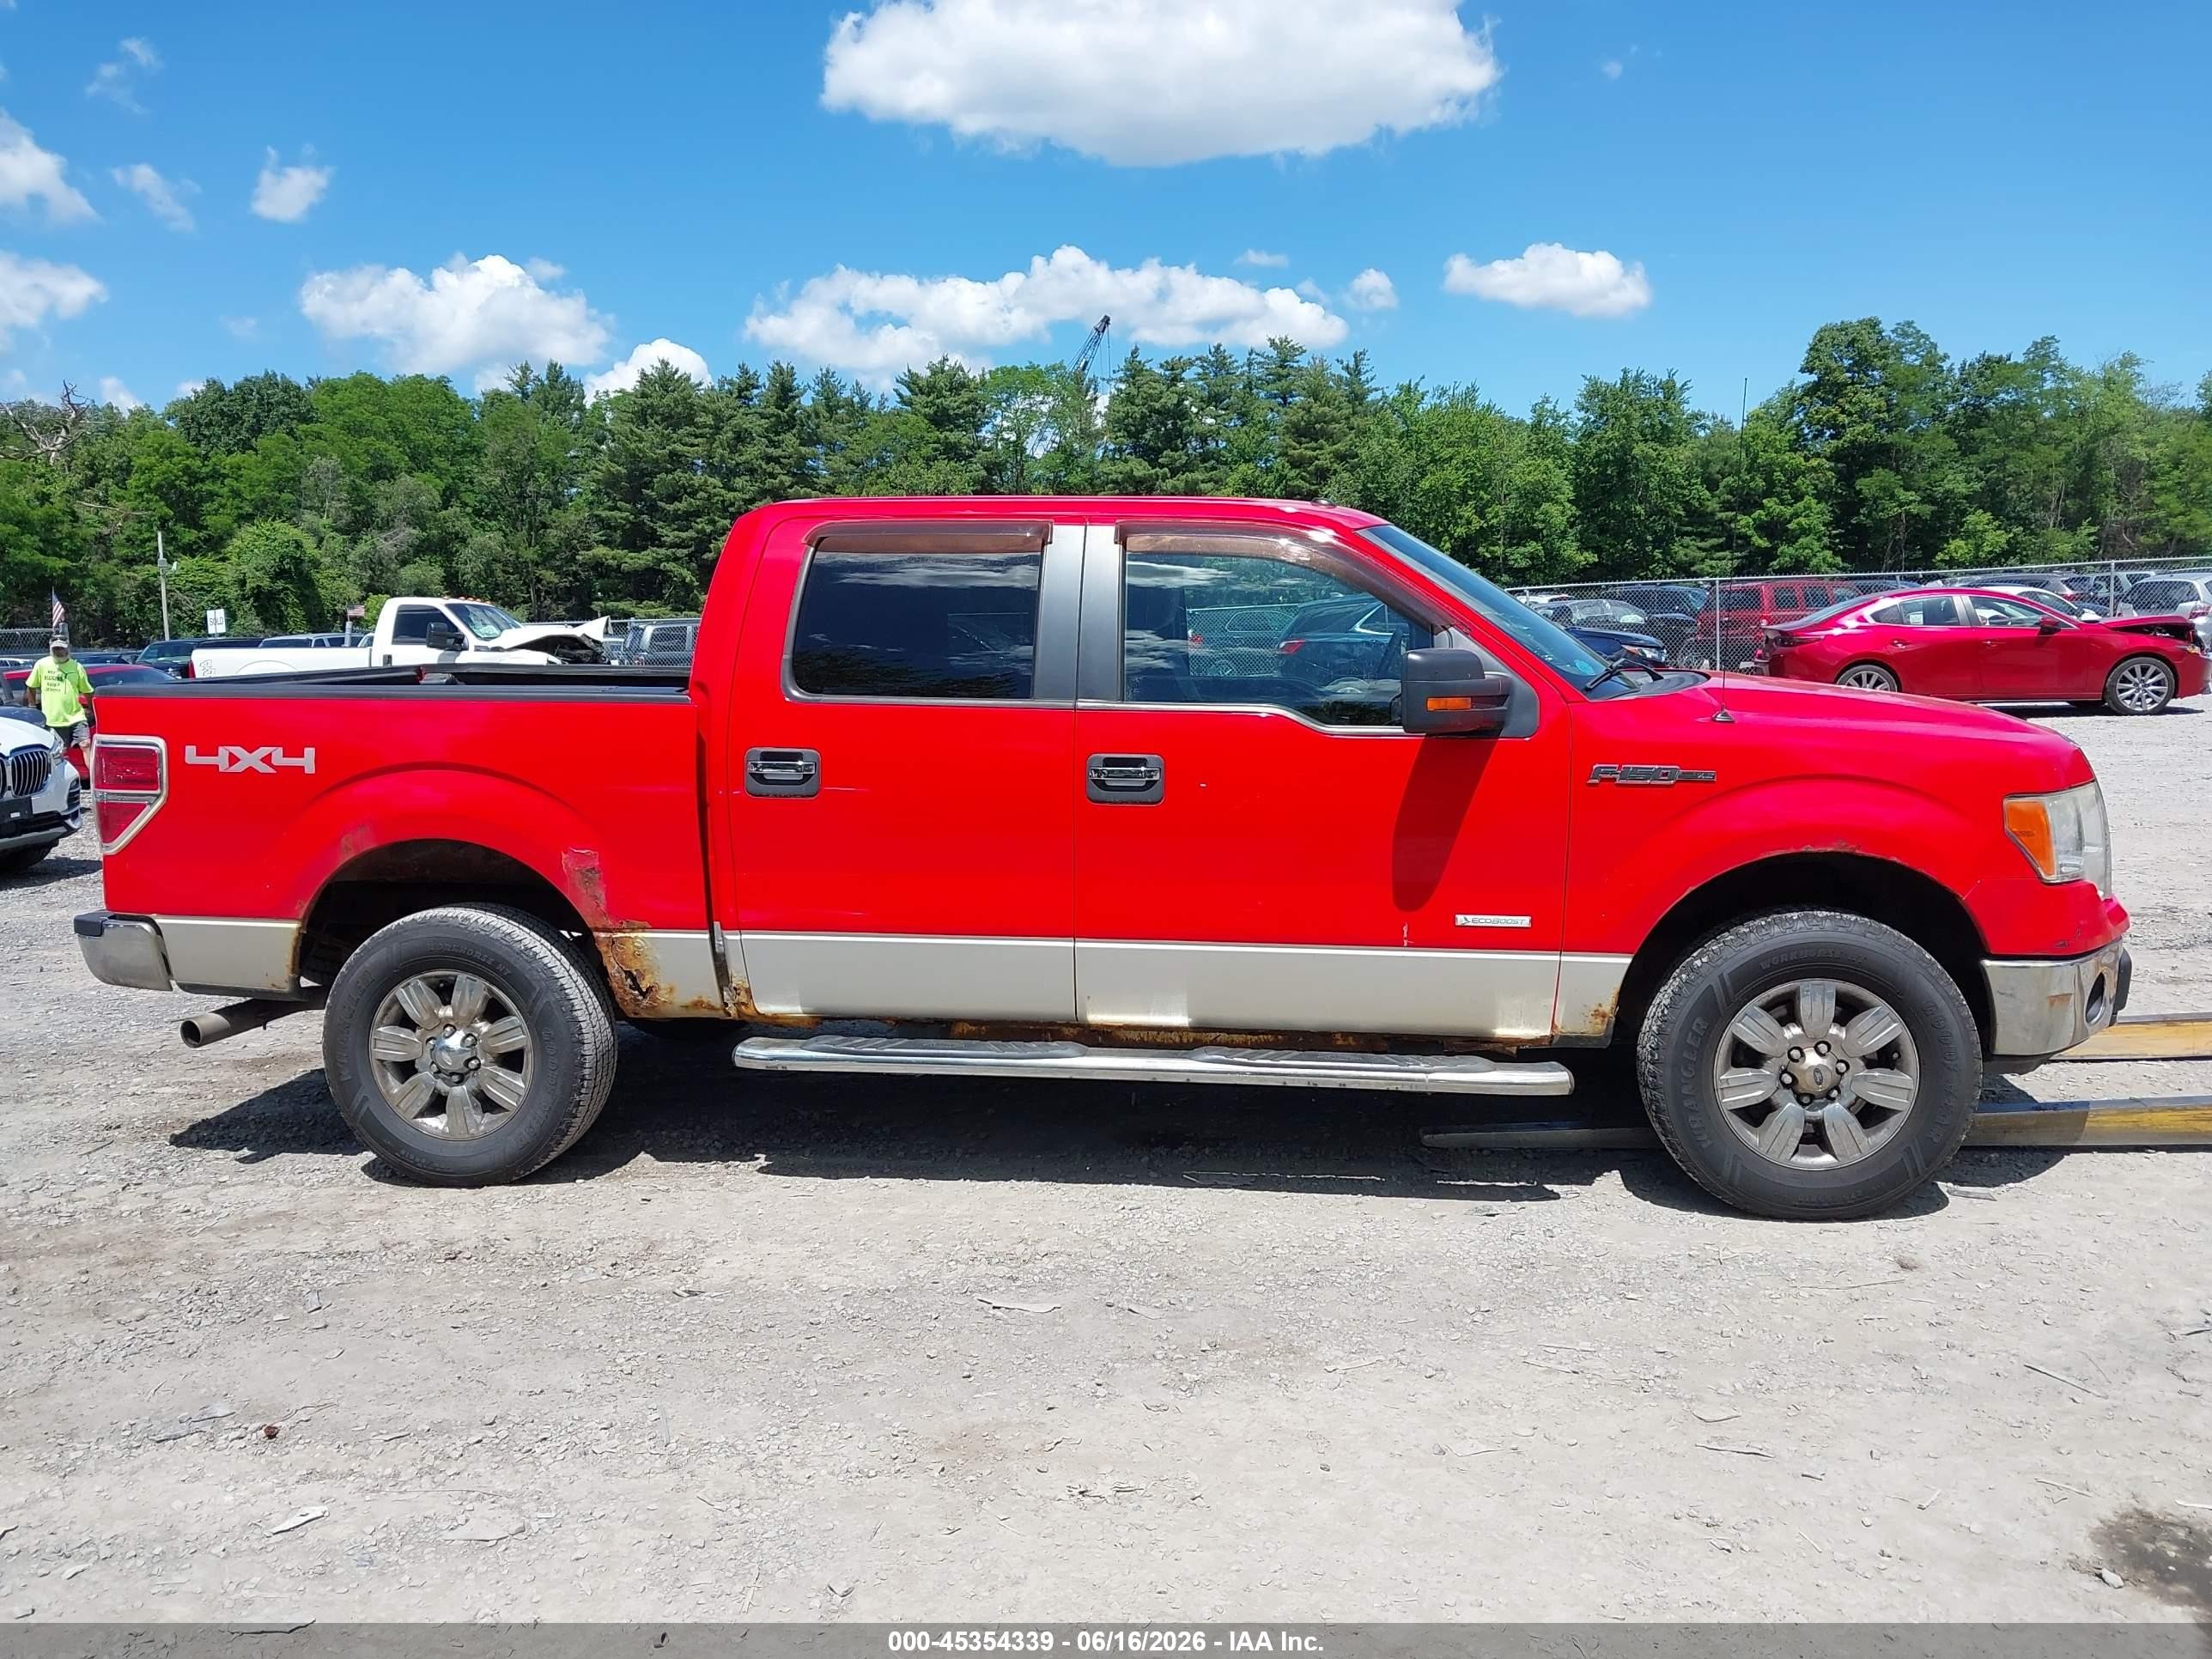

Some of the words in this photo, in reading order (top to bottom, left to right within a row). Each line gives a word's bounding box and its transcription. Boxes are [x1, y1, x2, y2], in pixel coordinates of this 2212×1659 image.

[209, 617, 224, 626] SOLD
[185, 745, 316, 774] 4X4
[1587, 763, 1680, 785] F-150
